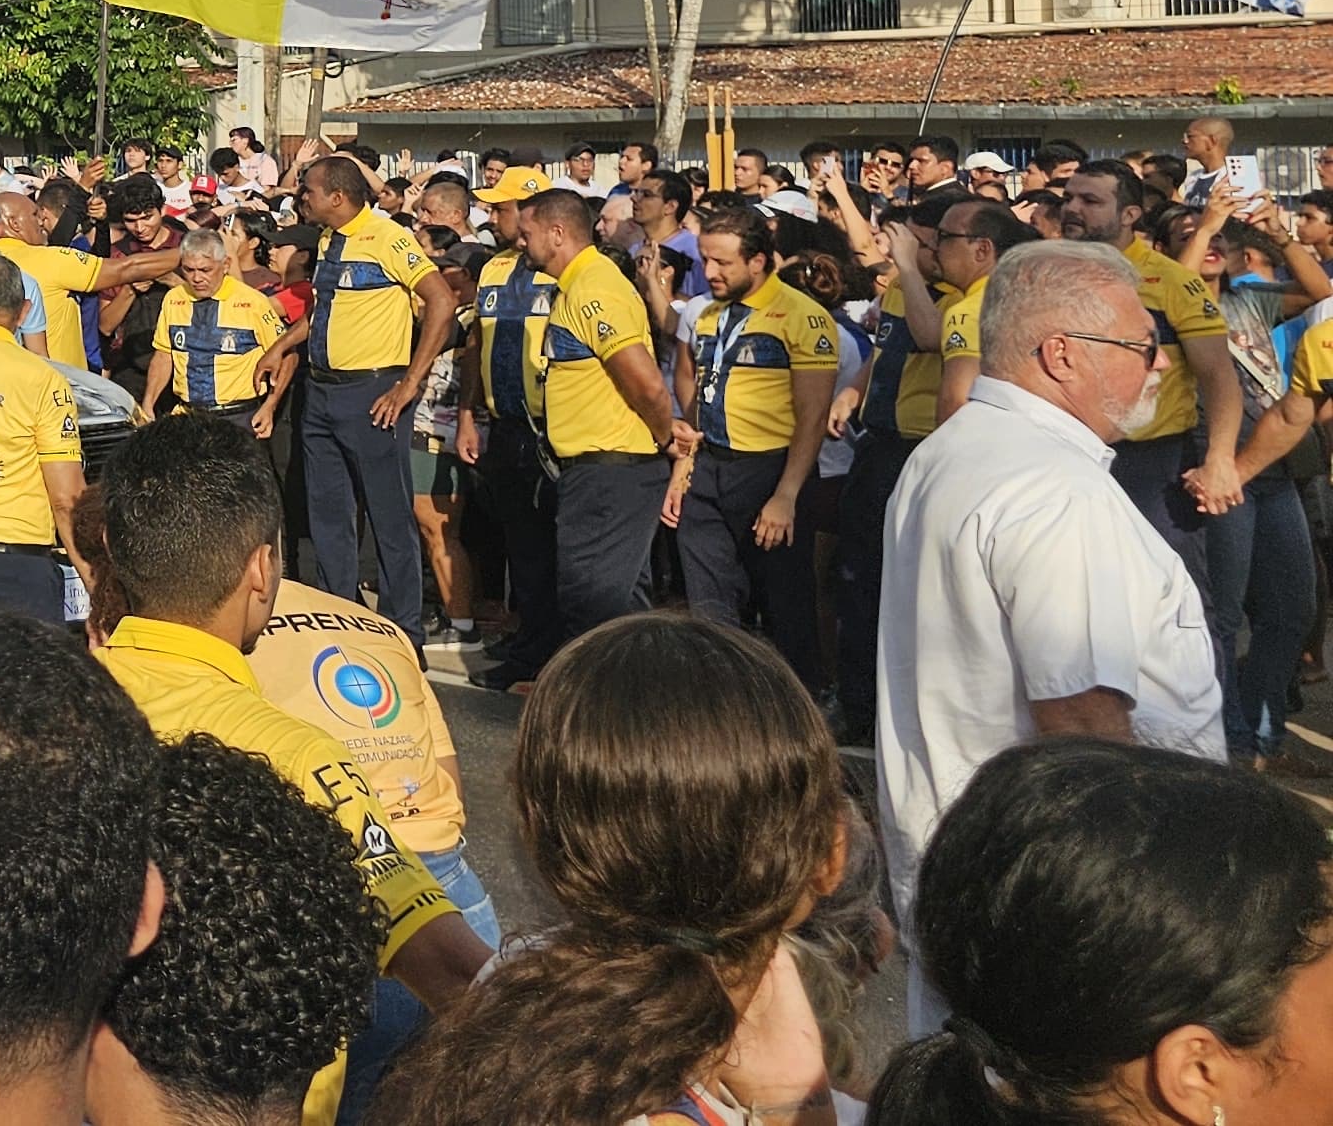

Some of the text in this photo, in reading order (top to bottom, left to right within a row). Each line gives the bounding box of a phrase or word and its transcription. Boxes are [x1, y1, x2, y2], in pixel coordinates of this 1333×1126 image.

[391, 237, 411, 253] NB
[1182, 278, 1206, 297] NB
[580, 299, 605, 320] DR
[807, 315, 829, 330] DR
[947, 313, 969, 328] AT
[52, 389, 73, 408] E4
[262, 612, 405, 646] PRENSA
[312, 760, 370, 808] E5
